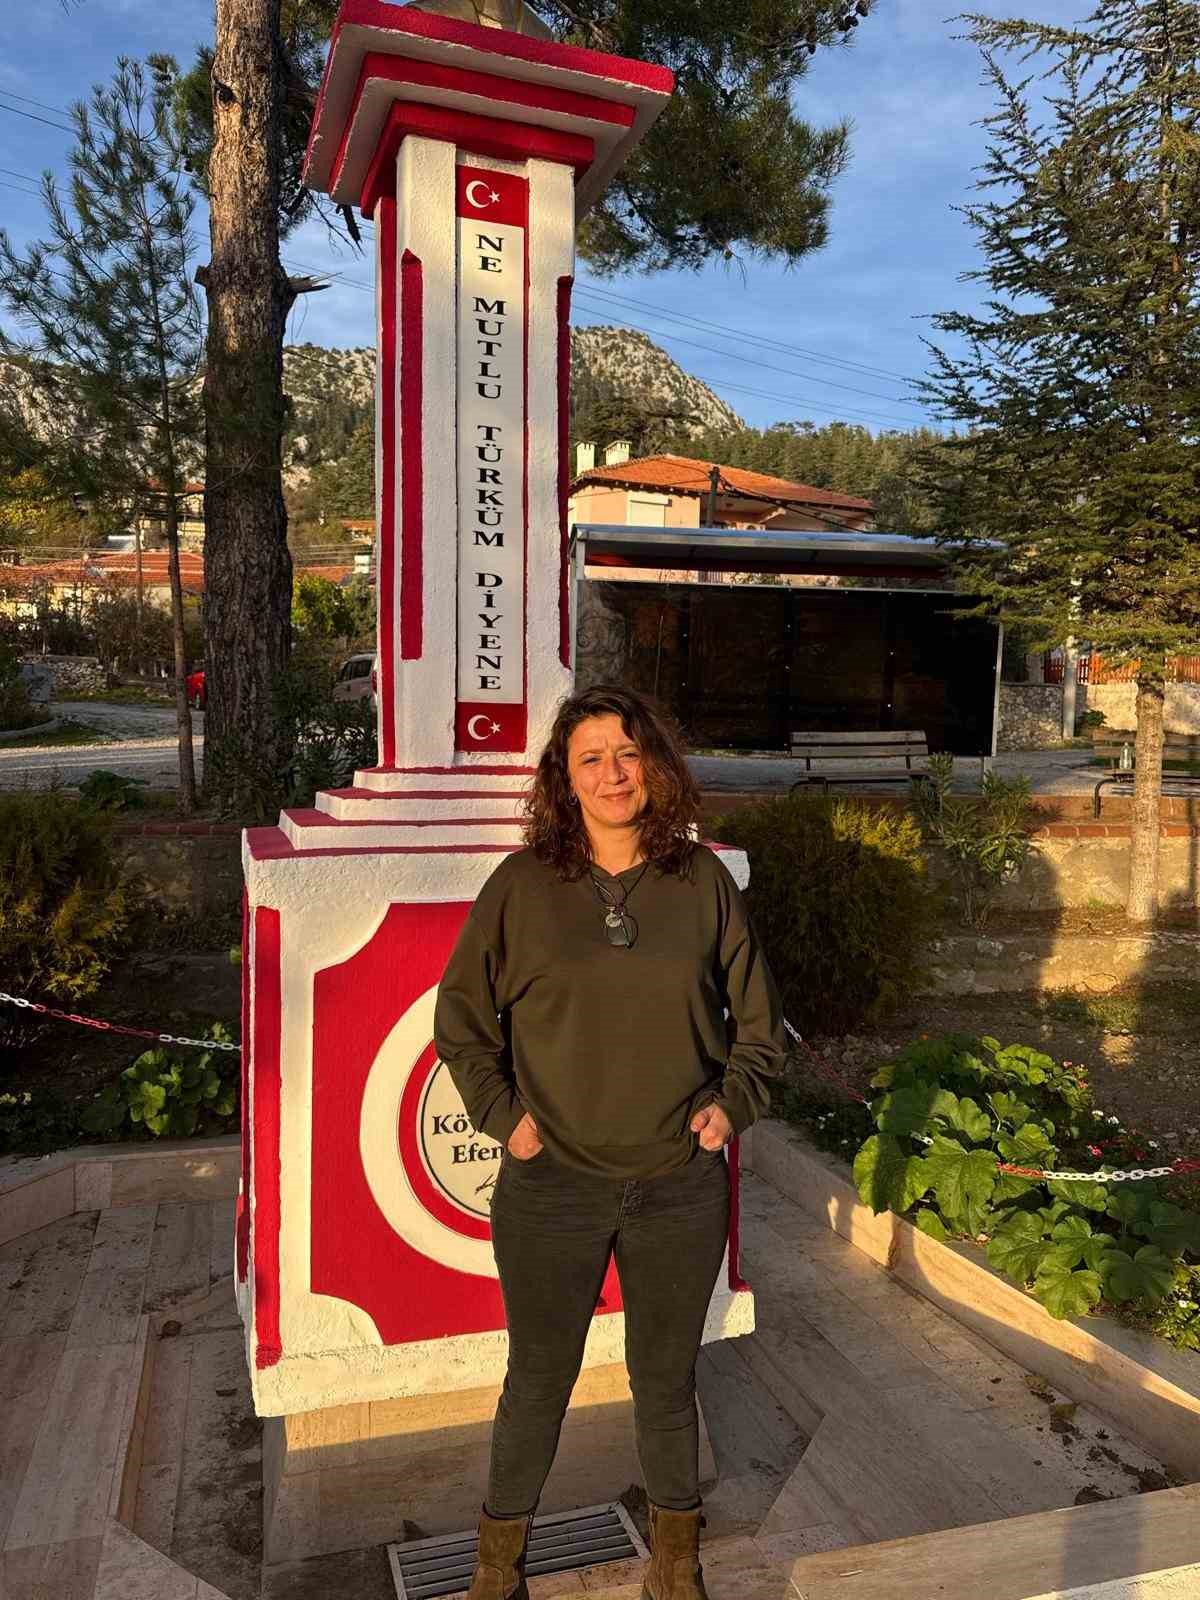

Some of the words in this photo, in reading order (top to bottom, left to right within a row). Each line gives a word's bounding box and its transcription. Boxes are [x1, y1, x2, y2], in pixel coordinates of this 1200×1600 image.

[476, 234, 504, 273] NE
[472, 297, 507, 399] MUTLU
[472, 425, 504, 547] TÜRKÜM
[475, 572, 503, 690] DİYENE
